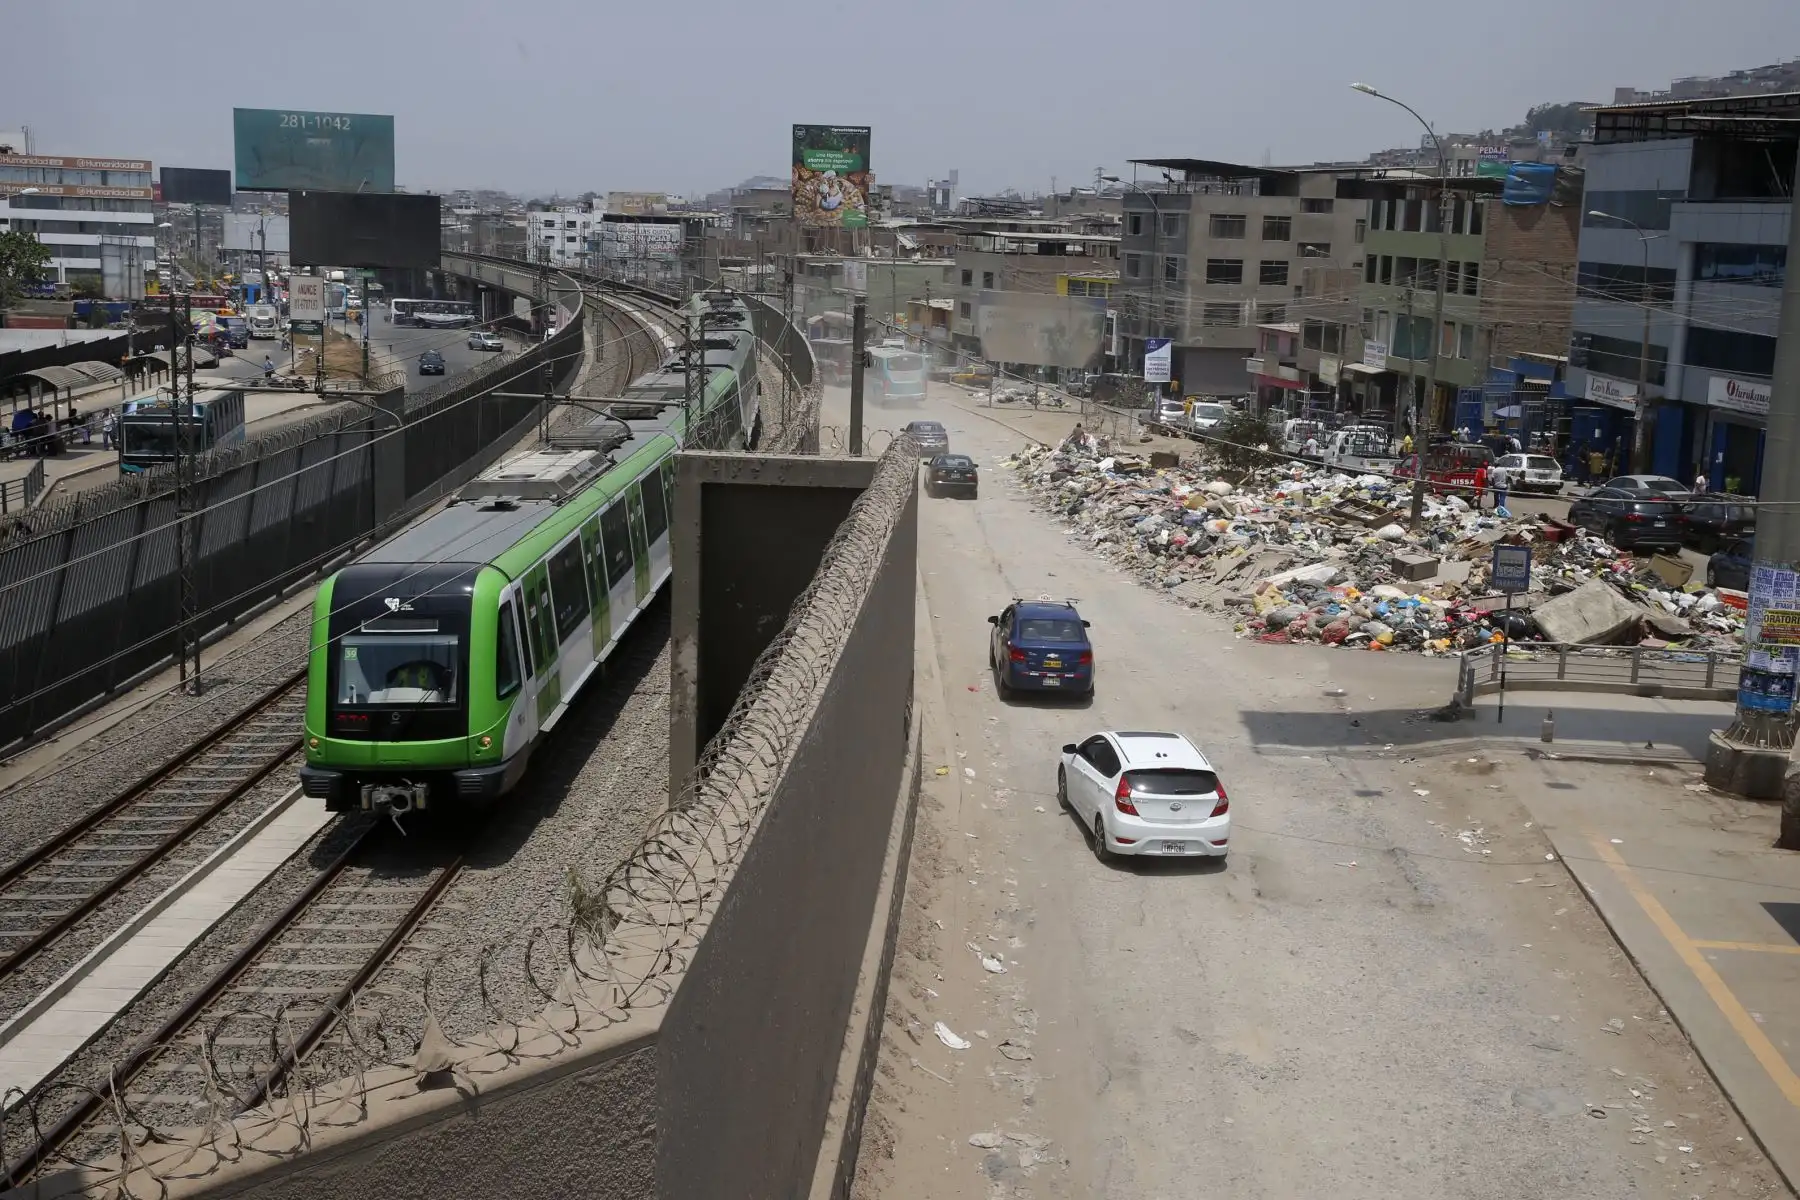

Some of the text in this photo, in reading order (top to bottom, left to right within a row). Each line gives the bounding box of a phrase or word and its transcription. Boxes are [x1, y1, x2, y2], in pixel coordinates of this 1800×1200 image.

[279, 114, 351, 130] 281-1042
[1479, 146, 1508, 155] PEDAJE
[3, 156, 48, 166] Humanidad
[86, 158, 131, 169] Humanidad
[86, 187, 131, 197] Humanidad
[1450, 478, 1475, 486] NISSA
